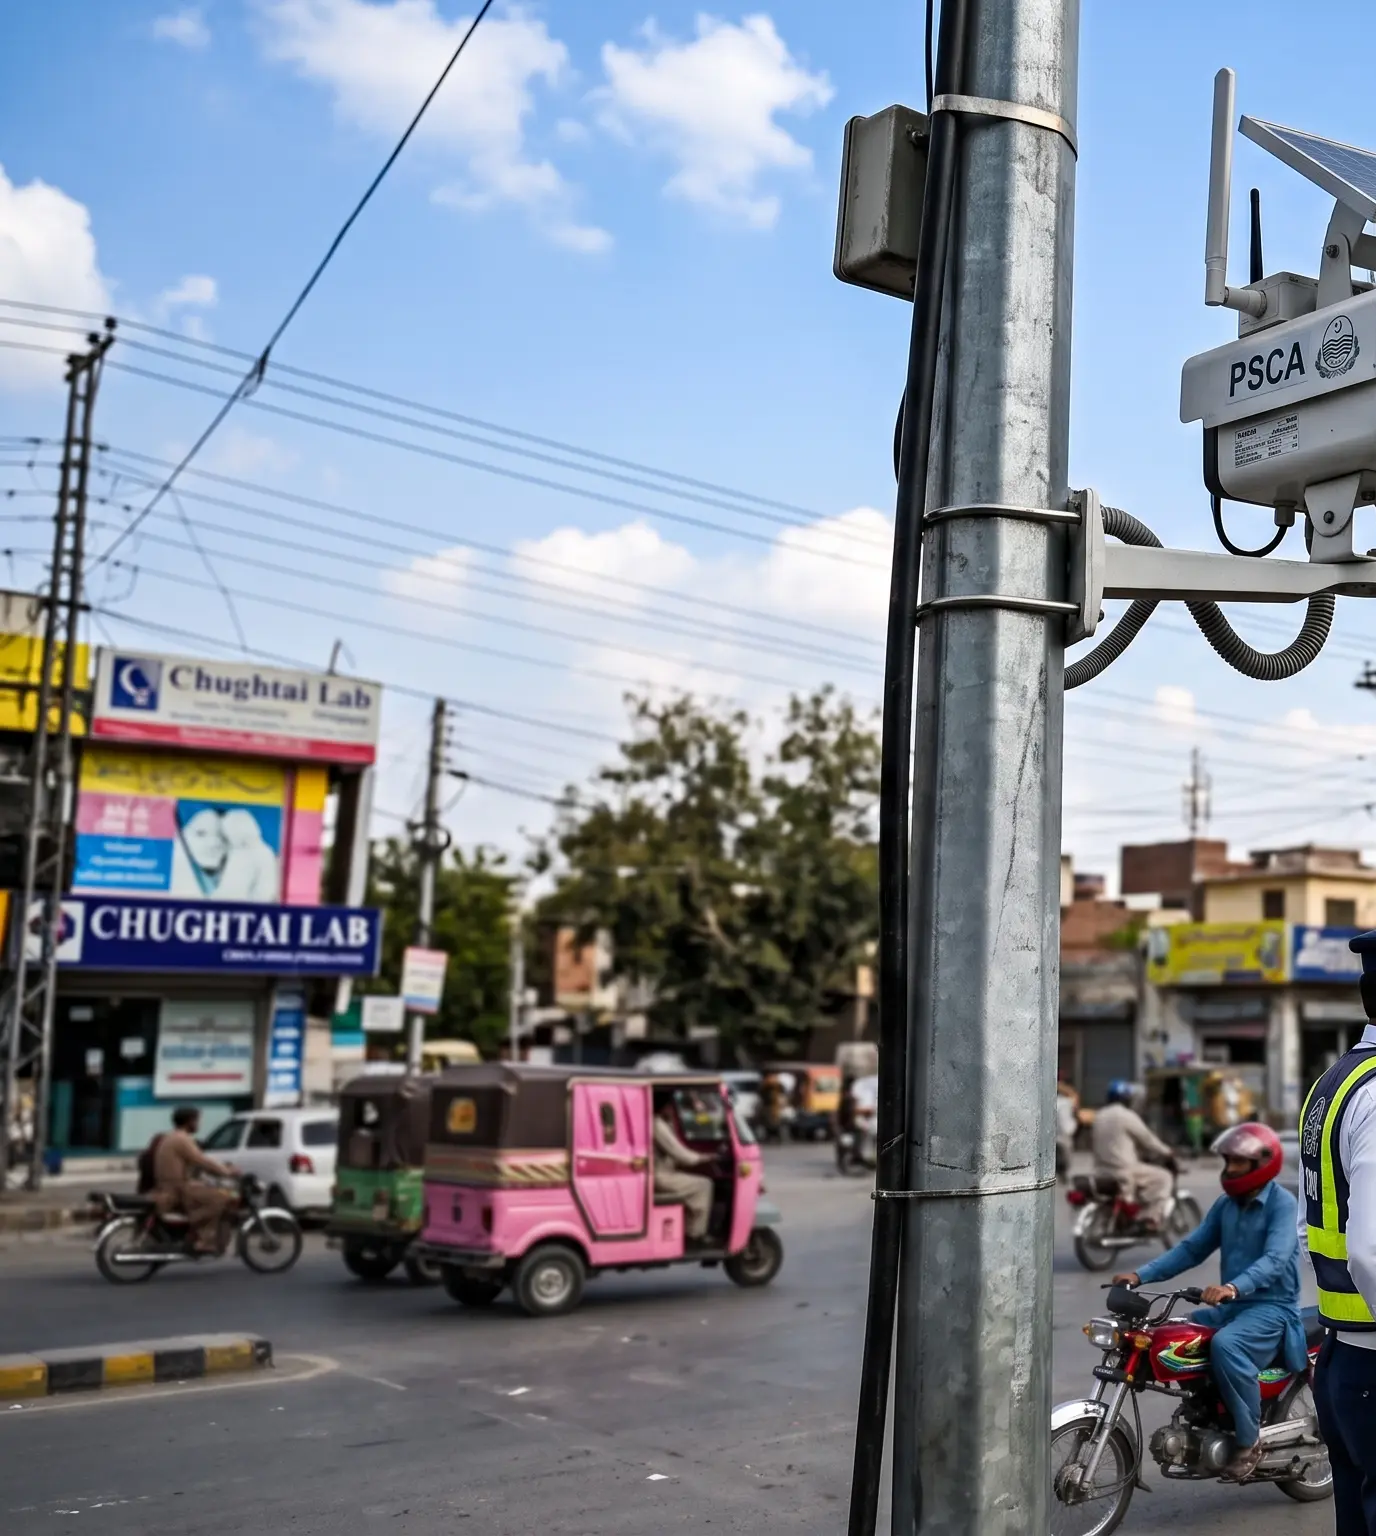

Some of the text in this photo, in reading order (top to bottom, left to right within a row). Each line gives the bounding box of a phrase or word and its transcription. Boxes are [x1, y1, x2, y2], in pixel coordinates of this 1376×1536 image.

[1229, 341, 1306, 398] PSCA
[168, 664, 309, 703] Chughtai
[318, 681, 371, 710] Lab
[90, 905, 370, 947] CHUGHTAI LAB
